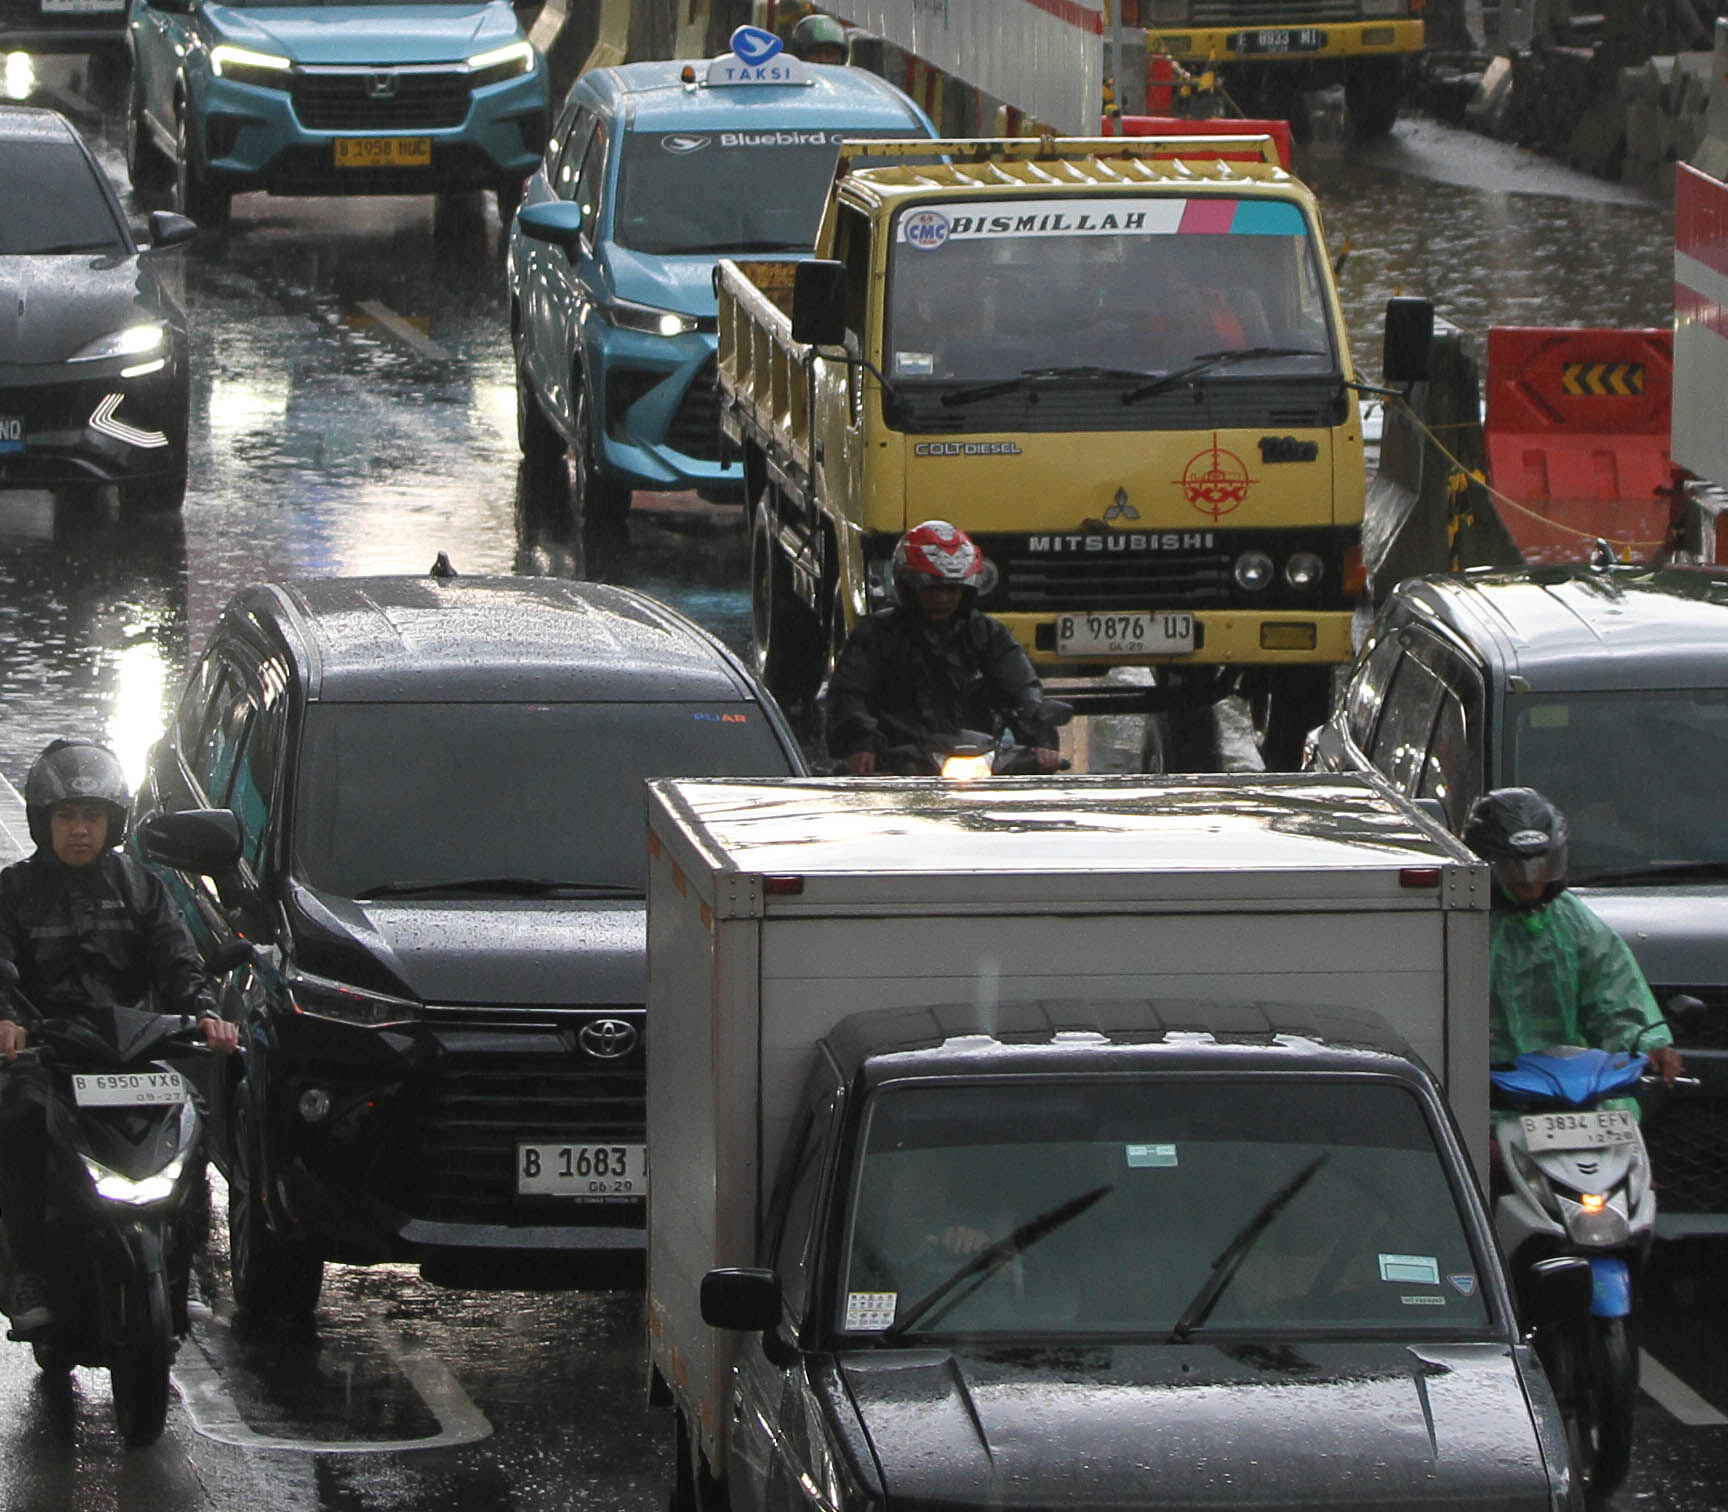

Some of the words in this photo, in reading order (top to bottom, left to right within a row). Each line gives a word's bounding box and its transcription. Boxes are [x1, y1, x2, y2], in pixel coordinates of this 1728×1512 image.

[728, 67, 791, 81] TAKSI
[720, 131, 826, 147] Bluebird
[952, 211, 1147, 234] BISMILLAH
[909, 224, 947, 239] CMC
[914, 442, 964, 457] COLT
[964, 441, 1022, 456] DIESEL
[1029, 533, 1215, 553] MITSUBISHI
[1060, 617, 1075, 640] B
[1089, 616, 1145, 640] 9876
[1164, 616, 1192, 640] UJ
[76, 1076, 87, 1090] B
[96, 1074, 140, 1090] 6950
[524, 1148, 542, 1178] B
[558, 1147, 627, 1177] 1683
